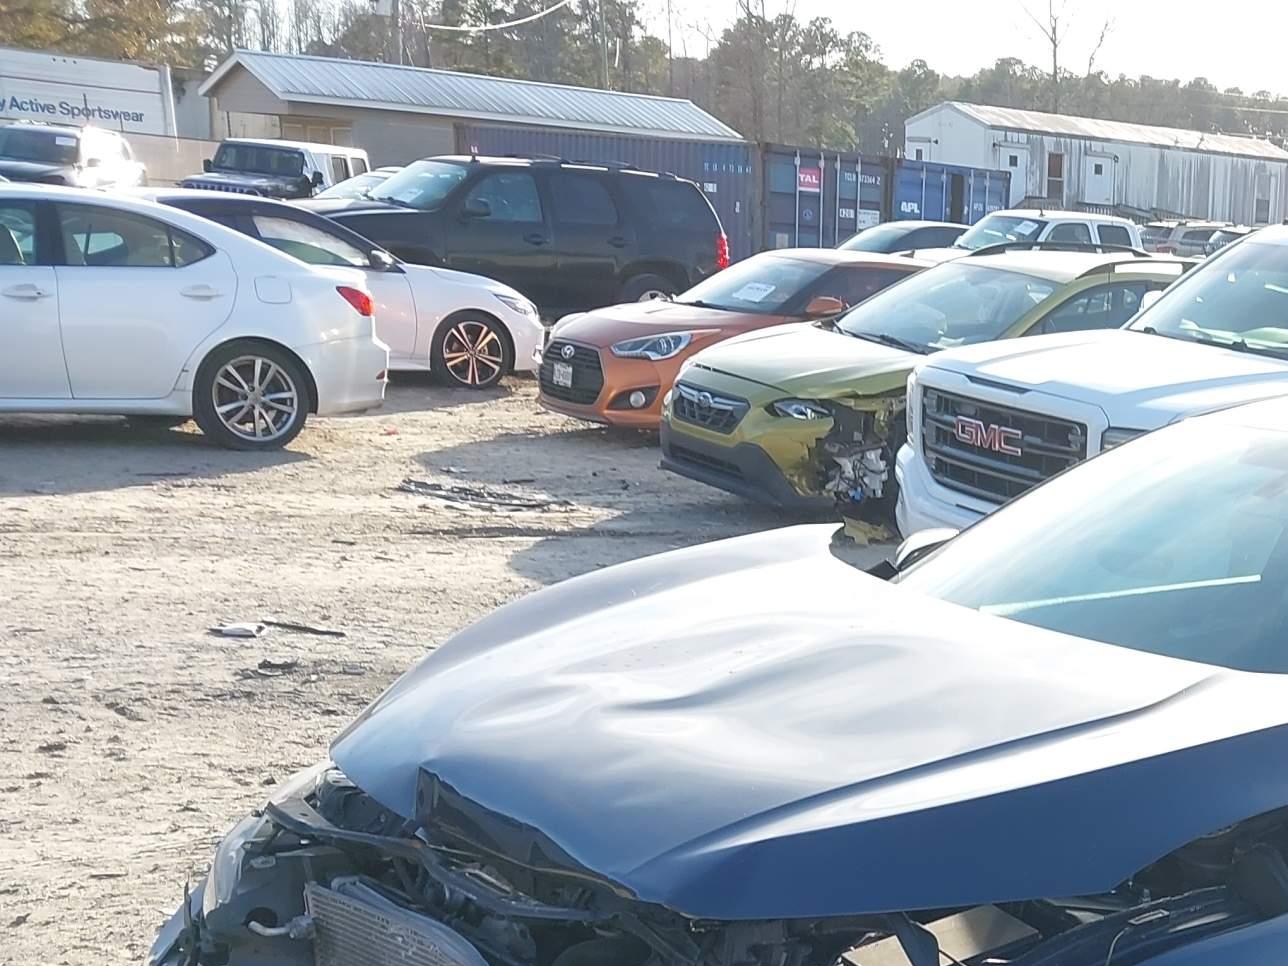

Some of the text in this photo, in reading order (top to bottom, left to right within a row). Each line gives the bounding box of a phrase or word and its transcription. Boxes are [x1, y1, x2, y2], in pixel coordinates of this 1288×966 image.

[9, 95, 57, 114] Active
[58, 101, 145, 123] Sportswear
[799, 173, 819, 184] TAL
[900, 201, 920, 214] APL
[952, 415, 1022, 457] GMC
